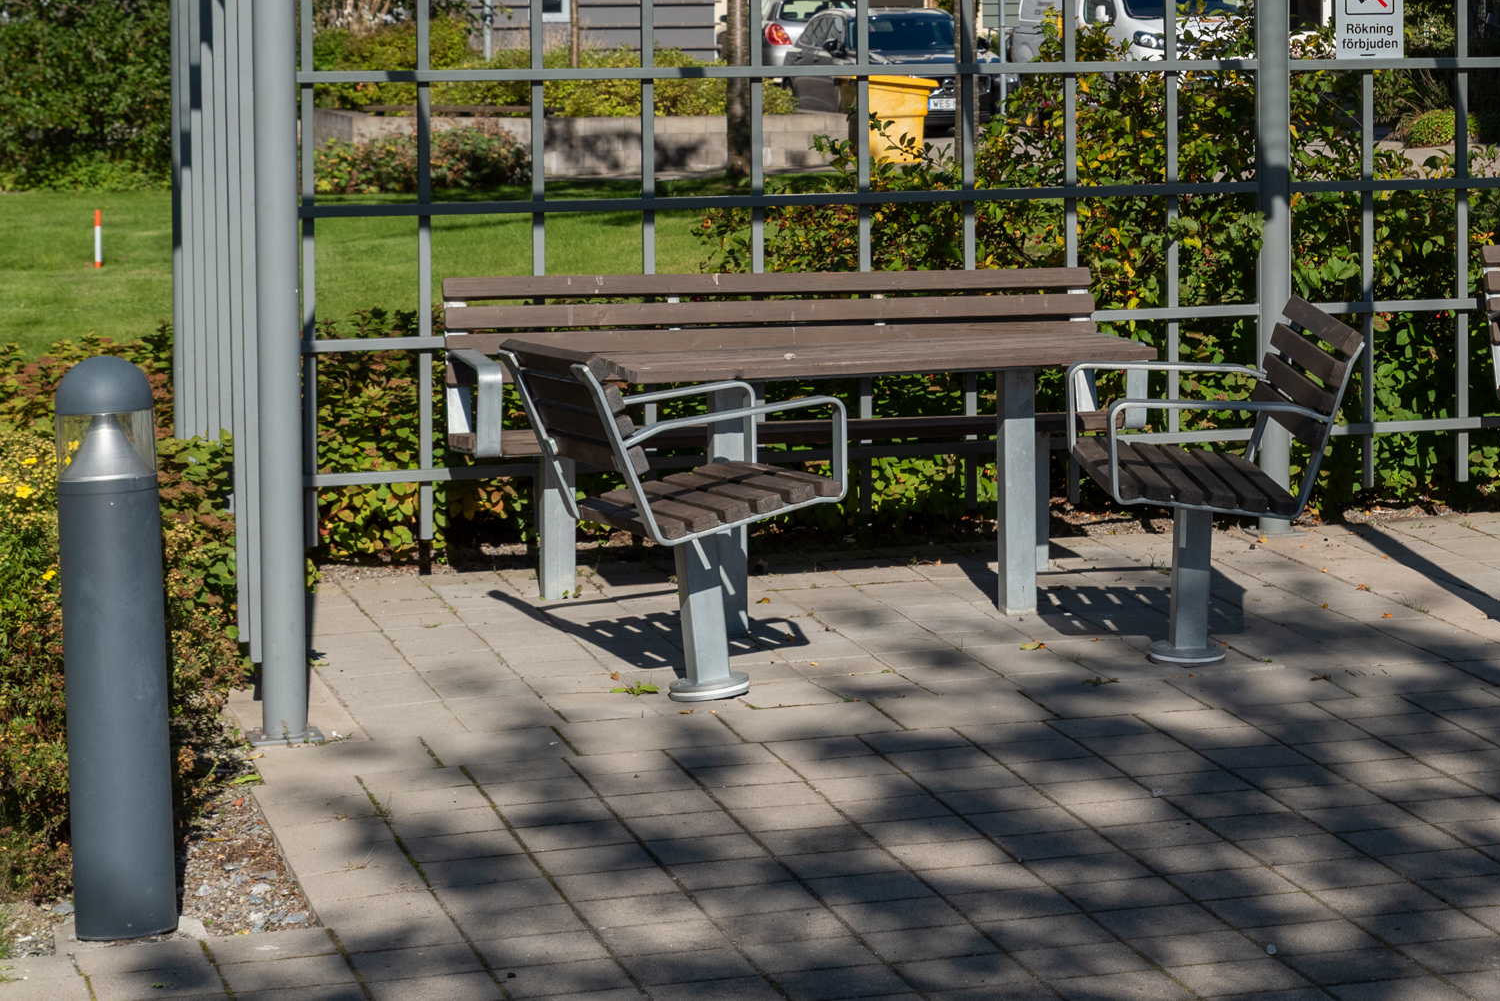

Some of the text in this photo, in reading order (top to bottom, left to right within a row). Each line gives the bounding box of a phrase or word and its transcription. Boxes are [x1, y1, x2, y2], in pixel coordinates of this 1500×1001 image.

[1346, 23, 1393, 36] Rökning
[1342, 38, 1398, 51] förbjuden
[933, 99, 950, 108] WES
